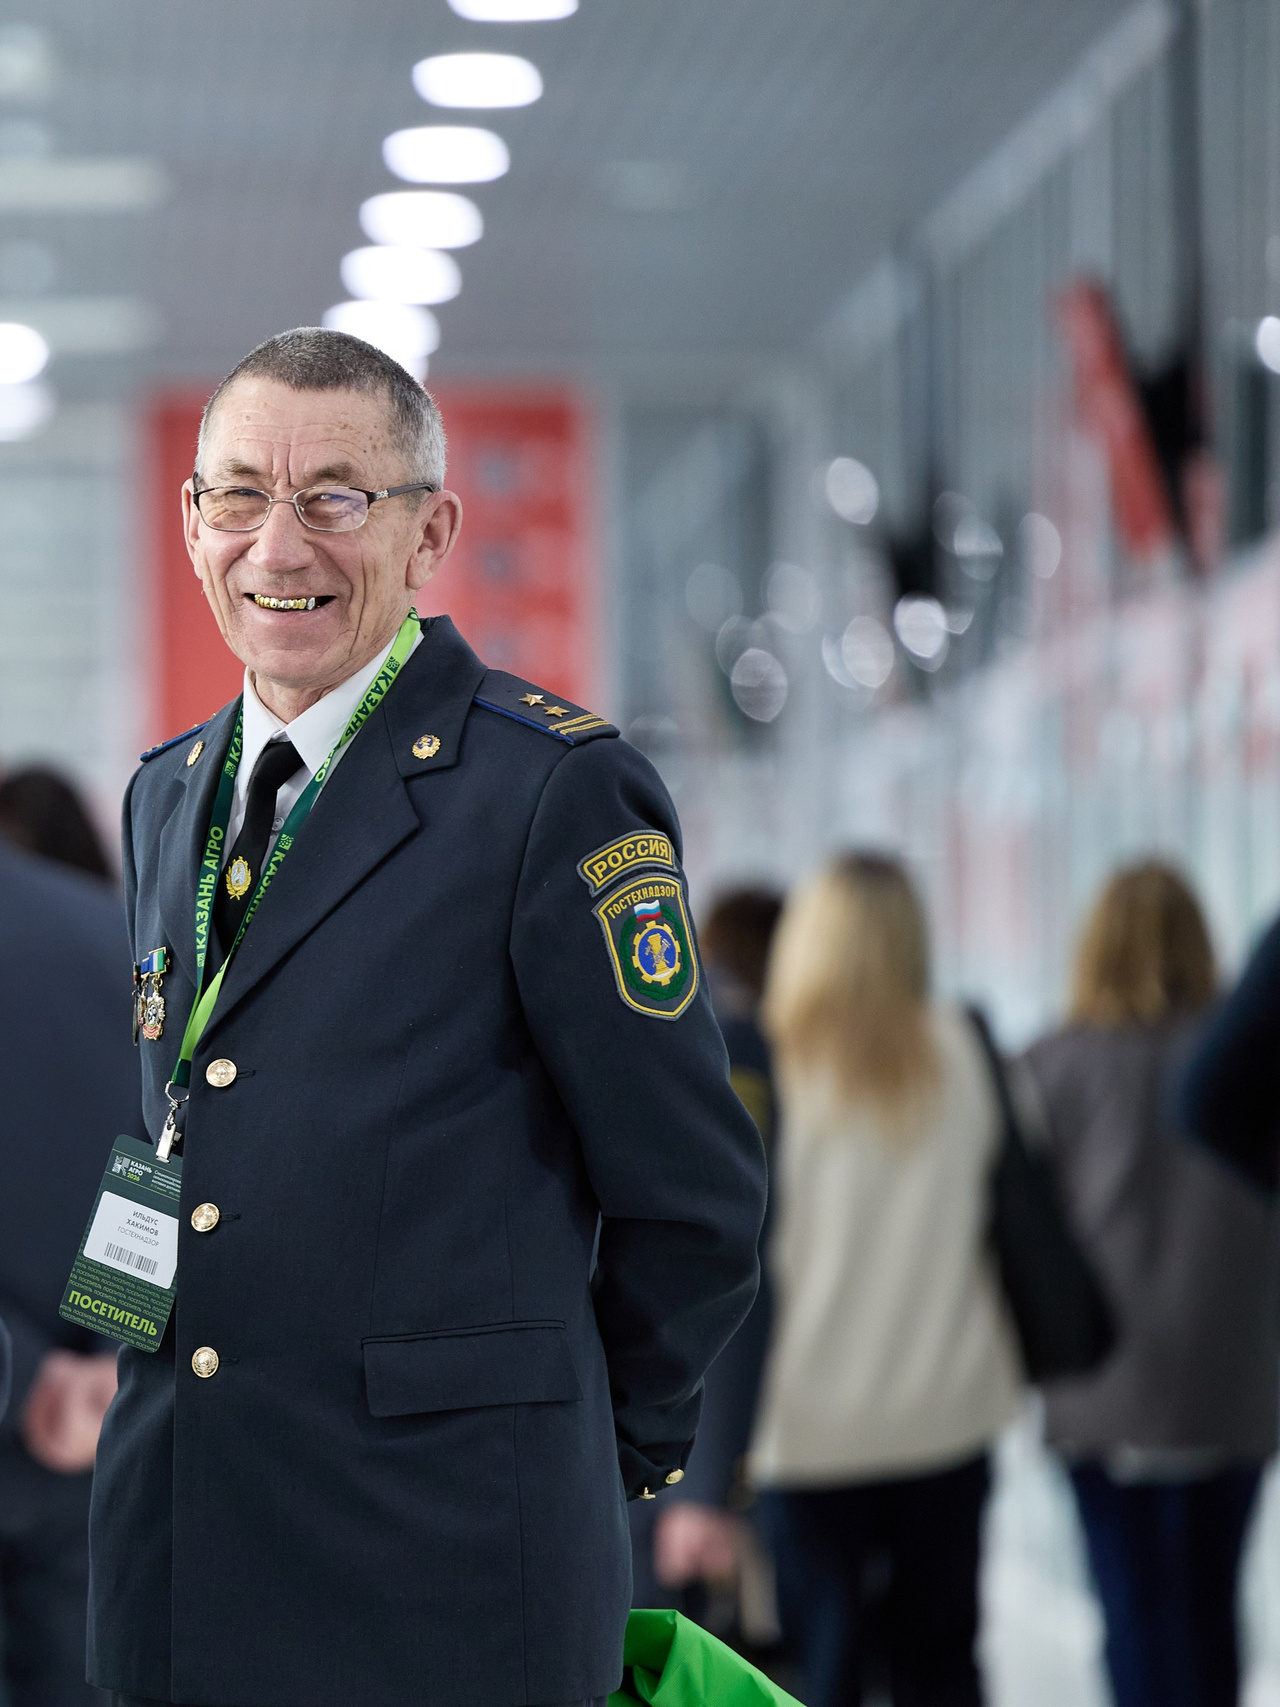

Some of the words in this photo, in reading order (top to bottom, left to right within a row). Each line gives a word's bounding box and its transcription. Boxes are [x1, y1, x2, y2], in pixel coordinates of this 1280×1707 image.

[345, 669, 393, 738] КАЗАНЬ
[204, 826, 224, 871] АГРО
[592, 839, 669, 879] РОССИЯ
[196, 873, 216, 950] КАЗАНЬ
[607, 885, 676, 919] ГОСТЕХНАДЗОР
[128, 1166, 144, 1176] АГРО
[130, 1160, 152, 1174] КАЗАНЬ
[126, 1218, 159, 1236] ХАКИМОВ
[132, 1210, 159, 1226] ИЛЬДУС
[117, 1226, 159, 1247] ГОСТЕХНАДЗОР
[68, 1290, 158, 1336] ПОСЕТИТЕЛЬ
